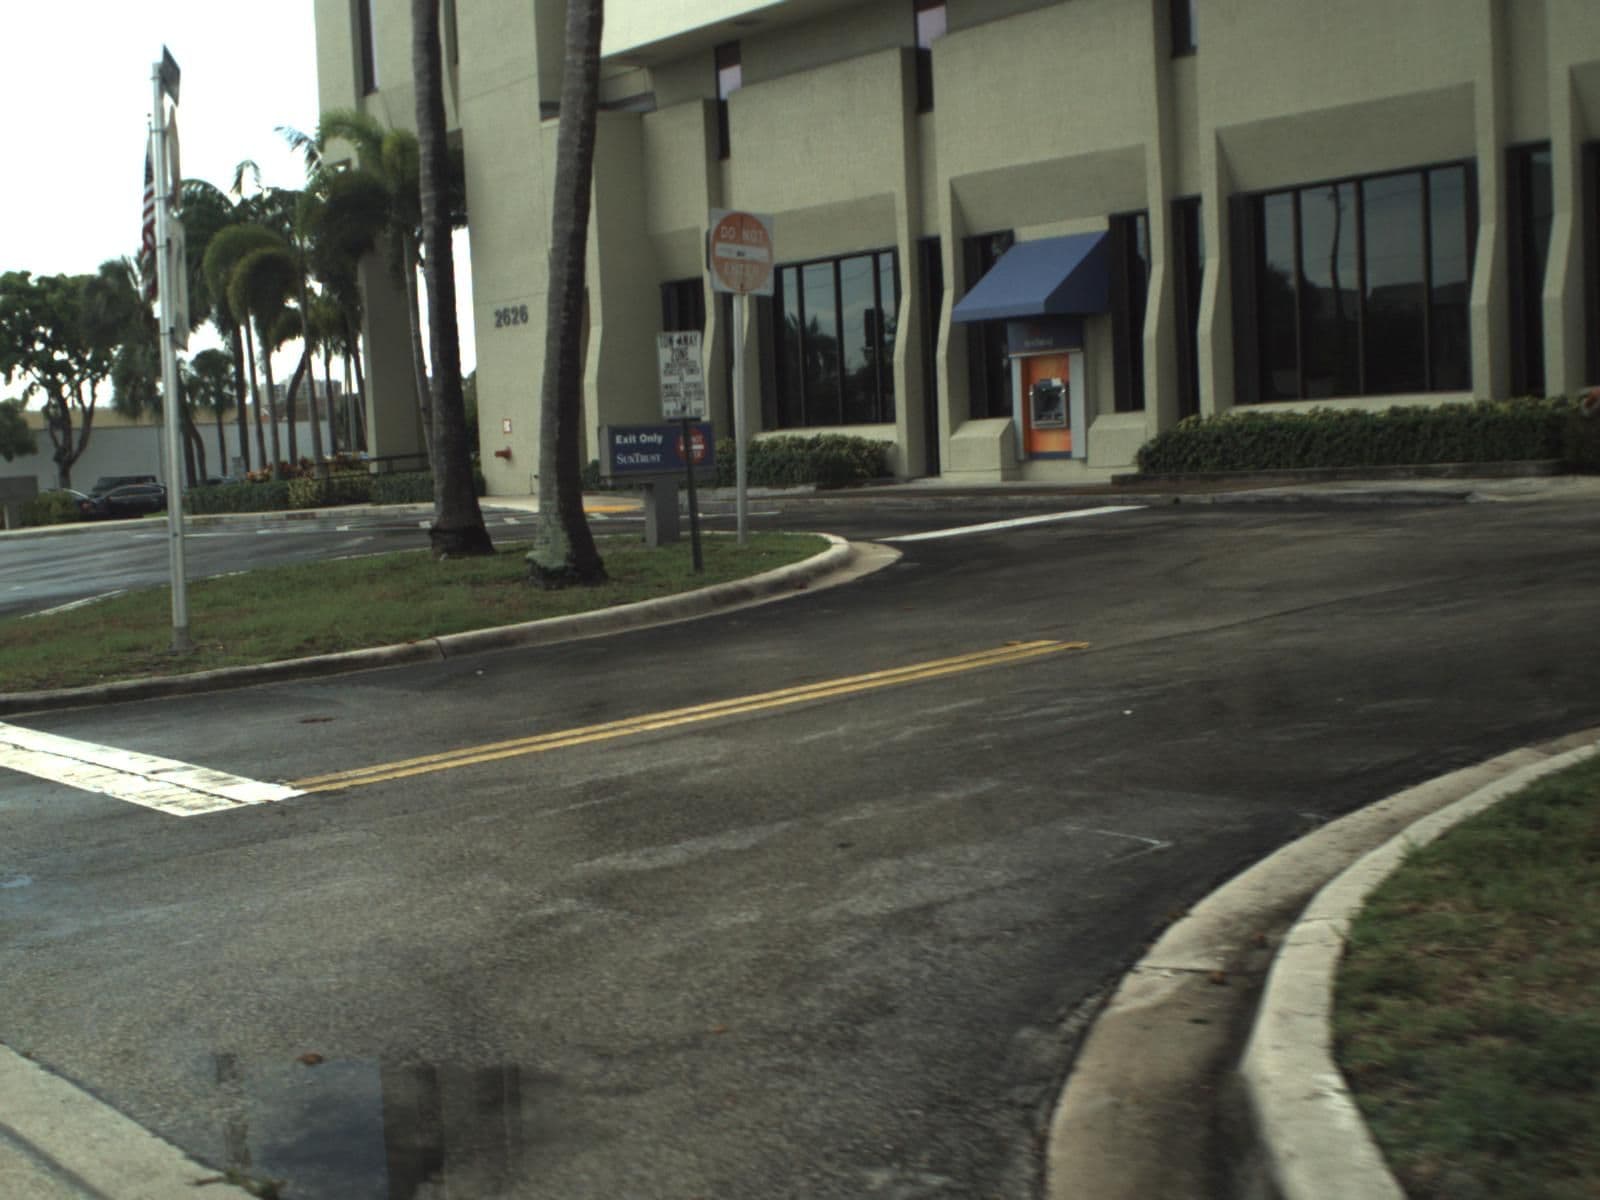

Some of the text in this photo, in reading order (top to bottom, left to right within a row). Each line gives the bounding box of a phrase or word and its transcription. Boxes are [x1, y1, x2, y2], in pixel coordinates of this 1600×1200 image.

[720, 226, 764, 242] DO NOT
[495, 304, 529, 328] 2626
[615, 433, 664, 445] Exit Only
